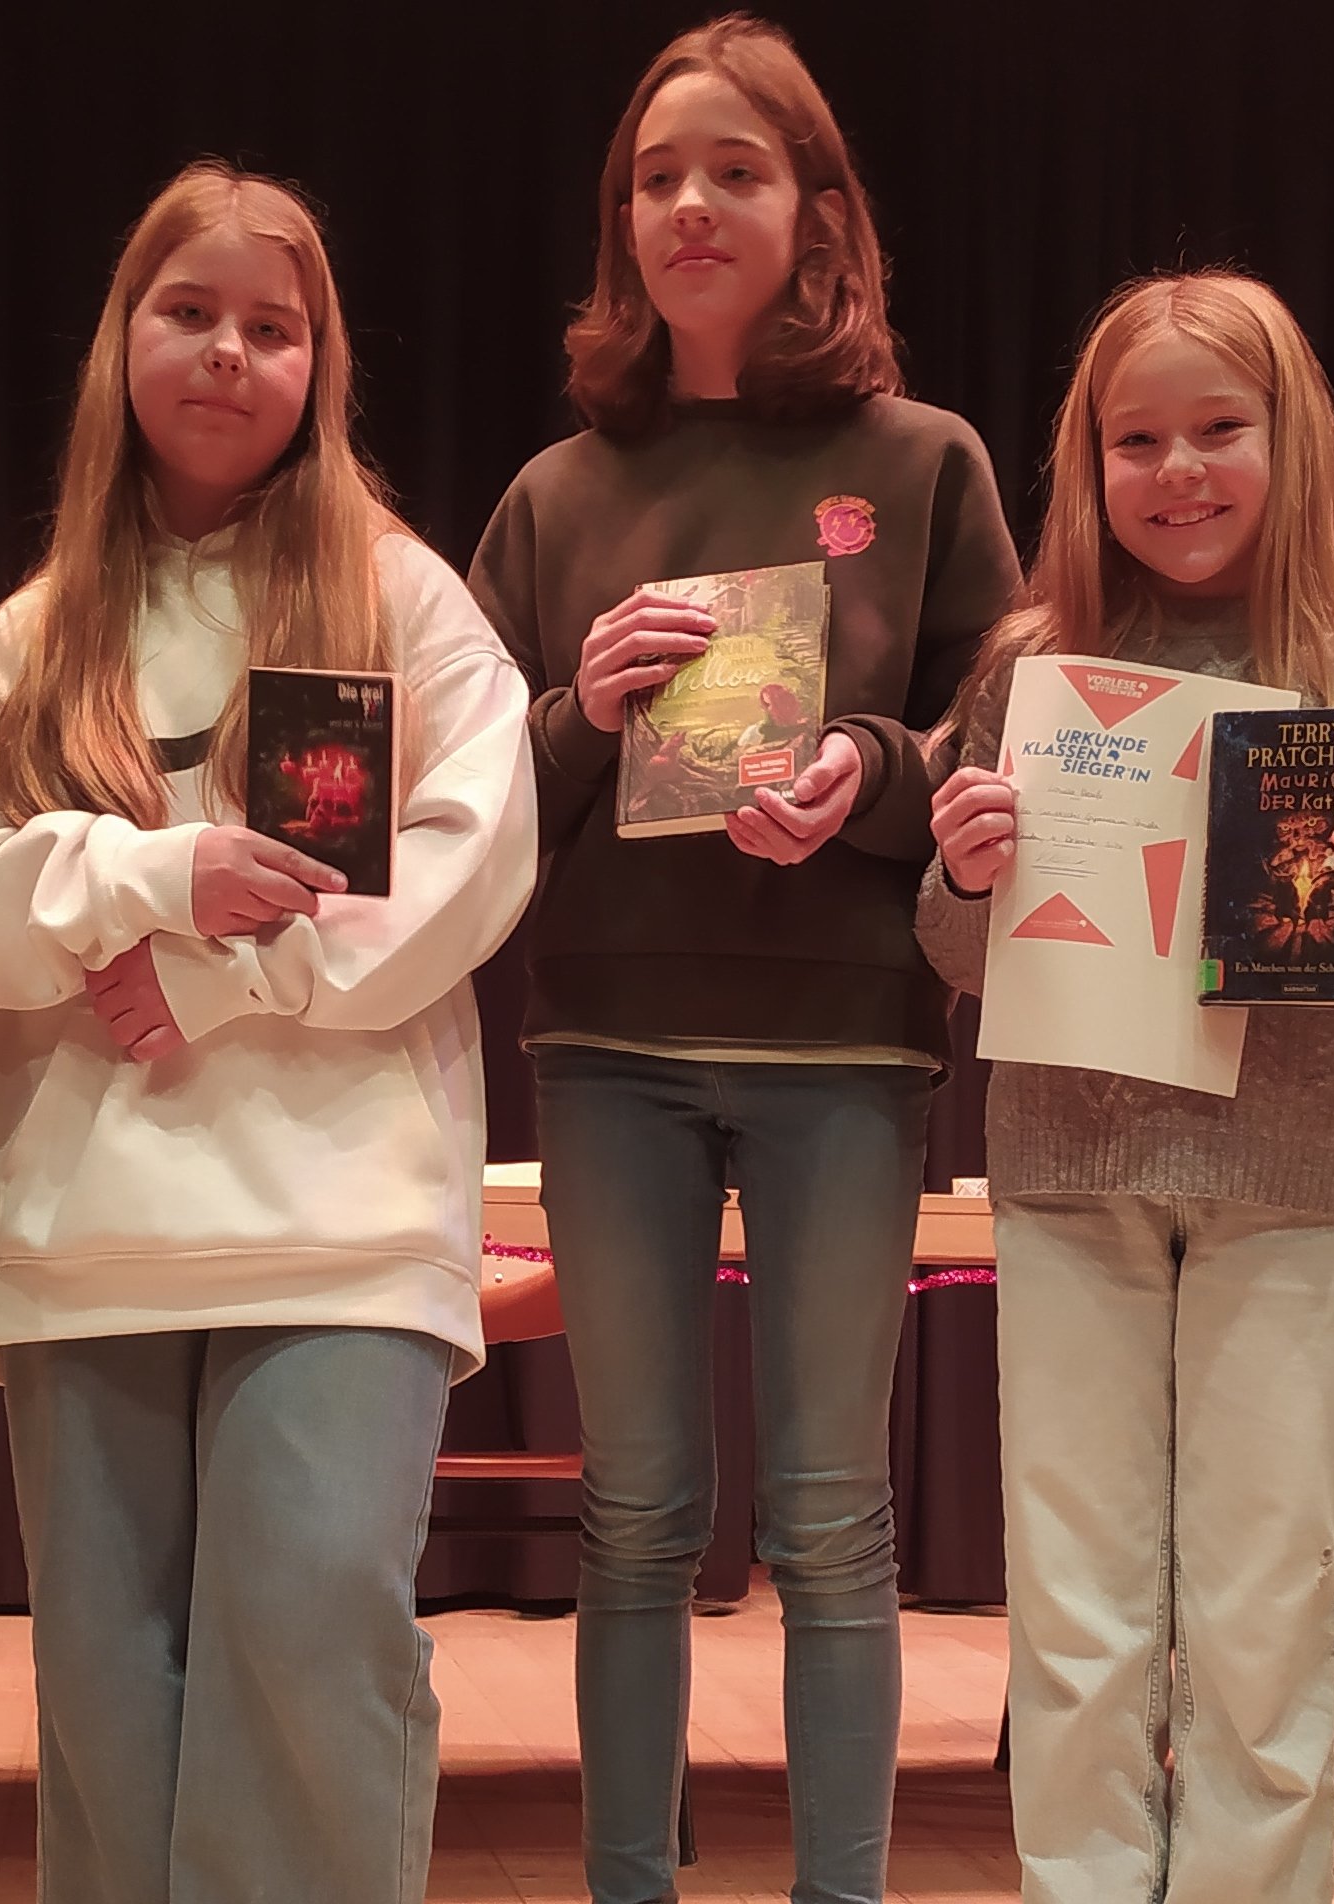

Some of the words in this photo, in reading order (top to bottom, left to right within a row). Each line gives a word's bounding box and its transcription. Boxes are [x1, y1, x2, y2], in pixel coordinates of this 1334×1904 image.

[1087, 674, 1137, 690] VORLESE
[1056, 728, 1148, 753] URKUNDE
[1022, 741, 1102, 761] KLASSEN
[1260, 792, 1295, 811] DER
